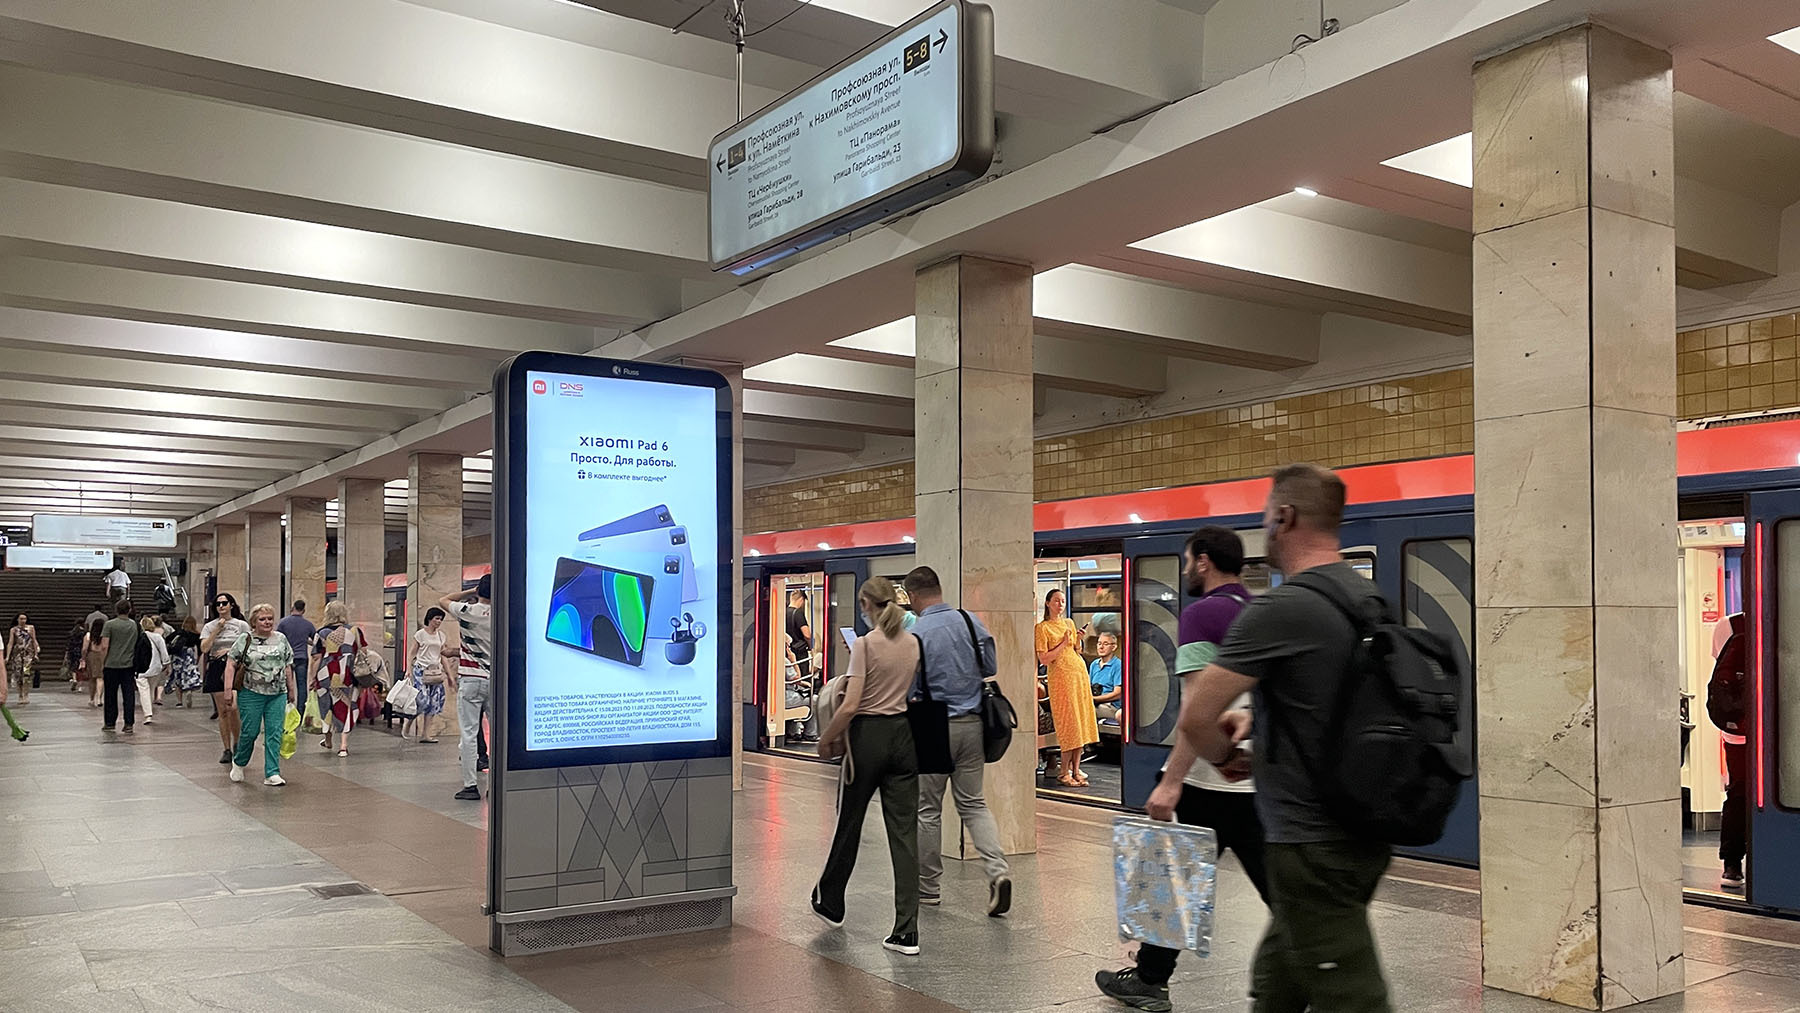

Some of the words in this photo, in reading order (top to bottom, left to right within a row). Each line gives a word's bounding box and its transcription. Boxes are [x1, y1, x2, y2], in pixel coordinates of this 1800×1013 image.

[906, 42, 928, 66] 5-8
[831, 64, 887, 102] Профсоюзная
[888, 56, 901, 72] ул.
[808, 120, 814, 128] к
[814, 87, 872, 126] Нахимовскому
[873, 73, 901, 94] просп.
[884, 86, 901, 100] Street
[880, 100, 901, 114] Avenue
[748, 117, 793, 148] Профсоюзная
[794, 112, 804, 126] ул.
[850, 136, 859, 148] ТЦ
[860, 120, 900, 143] «Панорама»
[751, 149, 762, 162] ул.
[762, 128, 800, 154] Намёткина
[833, 167, 851, 184] улица
[852, 150, 892, 172] Гарибальди,
[893, 142, 901, 153] 23
[748, 189, 756, 199] ТЦ
[748, 209, 762, 223] улица
[624, 368, 640, 376] Russ
[560, 382, 584, 391] DNS
[638, 440, 657, 450] Pad
[662, 441, 668, 451] 6
[570, 452, 612, 464] Просто.
[614, 455, 633, 466] Для
[636, 457, 676, 468] работы.
